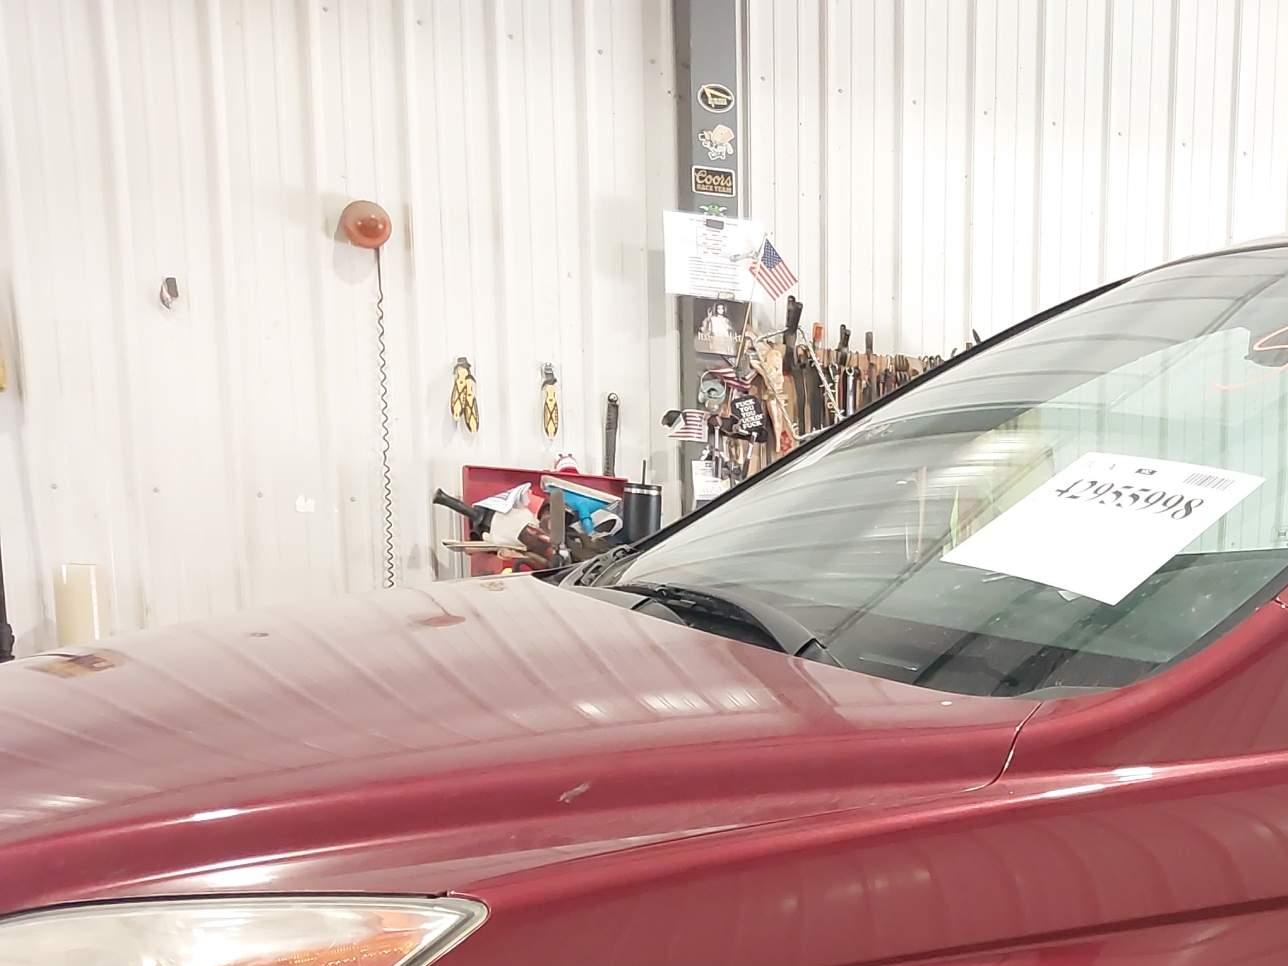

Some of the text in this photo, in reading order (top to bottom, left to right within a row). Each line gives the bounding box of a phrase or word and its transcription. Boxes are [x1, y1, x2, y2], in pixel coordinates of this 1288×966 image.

[695, 170, 732, 186] Coors
[735, 399, 755, 409] FUCK
[741, 410, 756, 418] YOU
[742, 420, 763, 429] FUCK
[1056, 478, 1204, 520] 42955998
